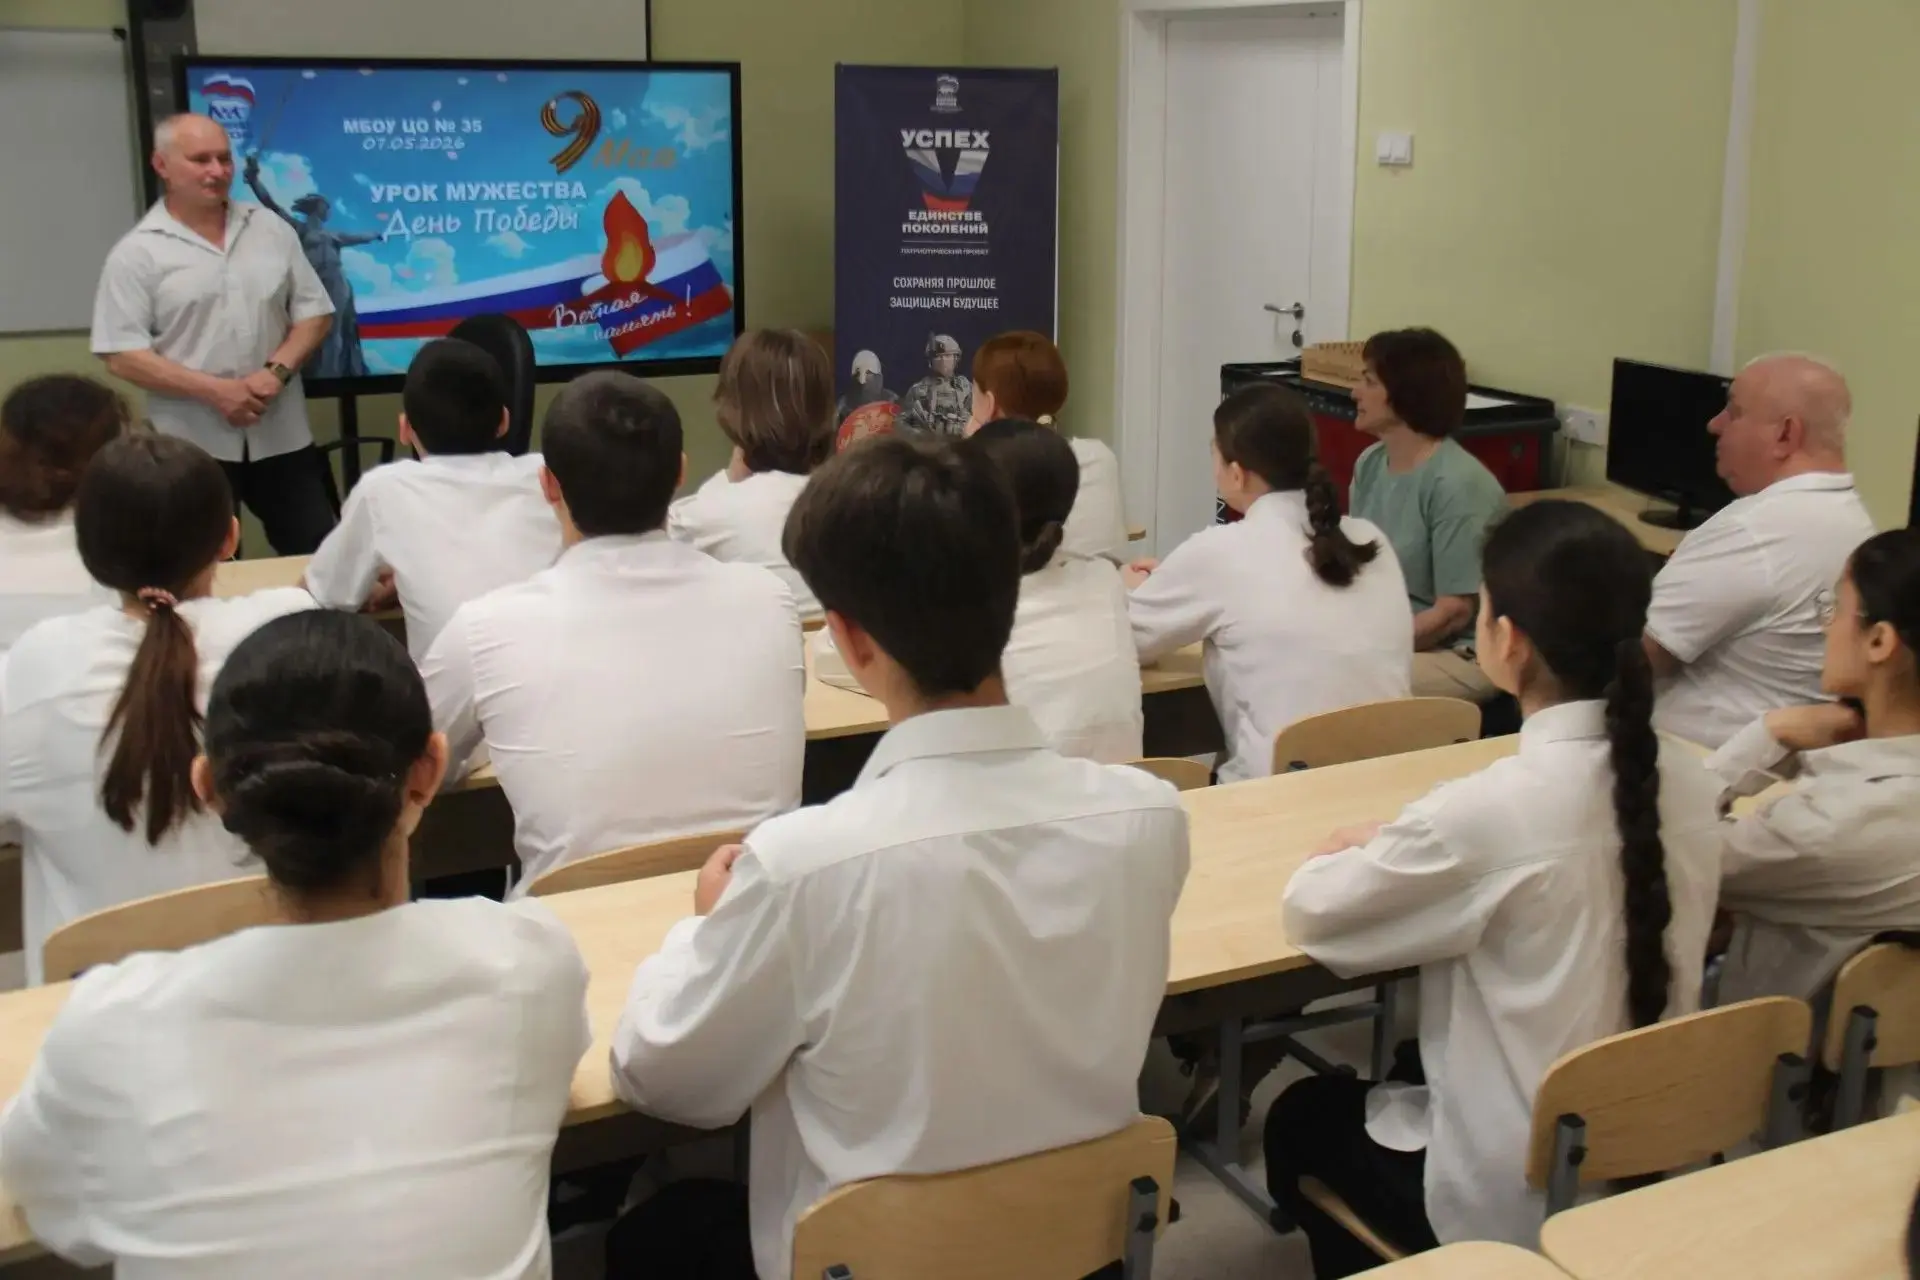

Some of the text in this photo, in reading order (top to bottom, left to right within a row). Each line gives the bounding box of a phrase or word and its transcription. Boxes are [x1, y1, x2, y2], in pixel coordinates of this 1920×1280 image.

[343, 118, 483, 135] МБОУ ЦО № 35
[540, 90, 600, 174] 9
[362, 135, 466, 151] 07.05.2026
[901, 129, 990, 149] УСПЕХ
[370, 181, 587, 203] УРОК МУЖЕСТВА
[381, 204, 579, 242] День Победы
[908, 210, 982, 222] ЕДИНСТВЕ
[902, 222, 989, 234] ПОКОЛЕНИЙ
[893, 276, 997, 290] СОХРАНЯЯ ПРОШЛОЕ
[890, 297, 999, 311] ЗАЩИЩАЕМ БУДУЩЕЕ
